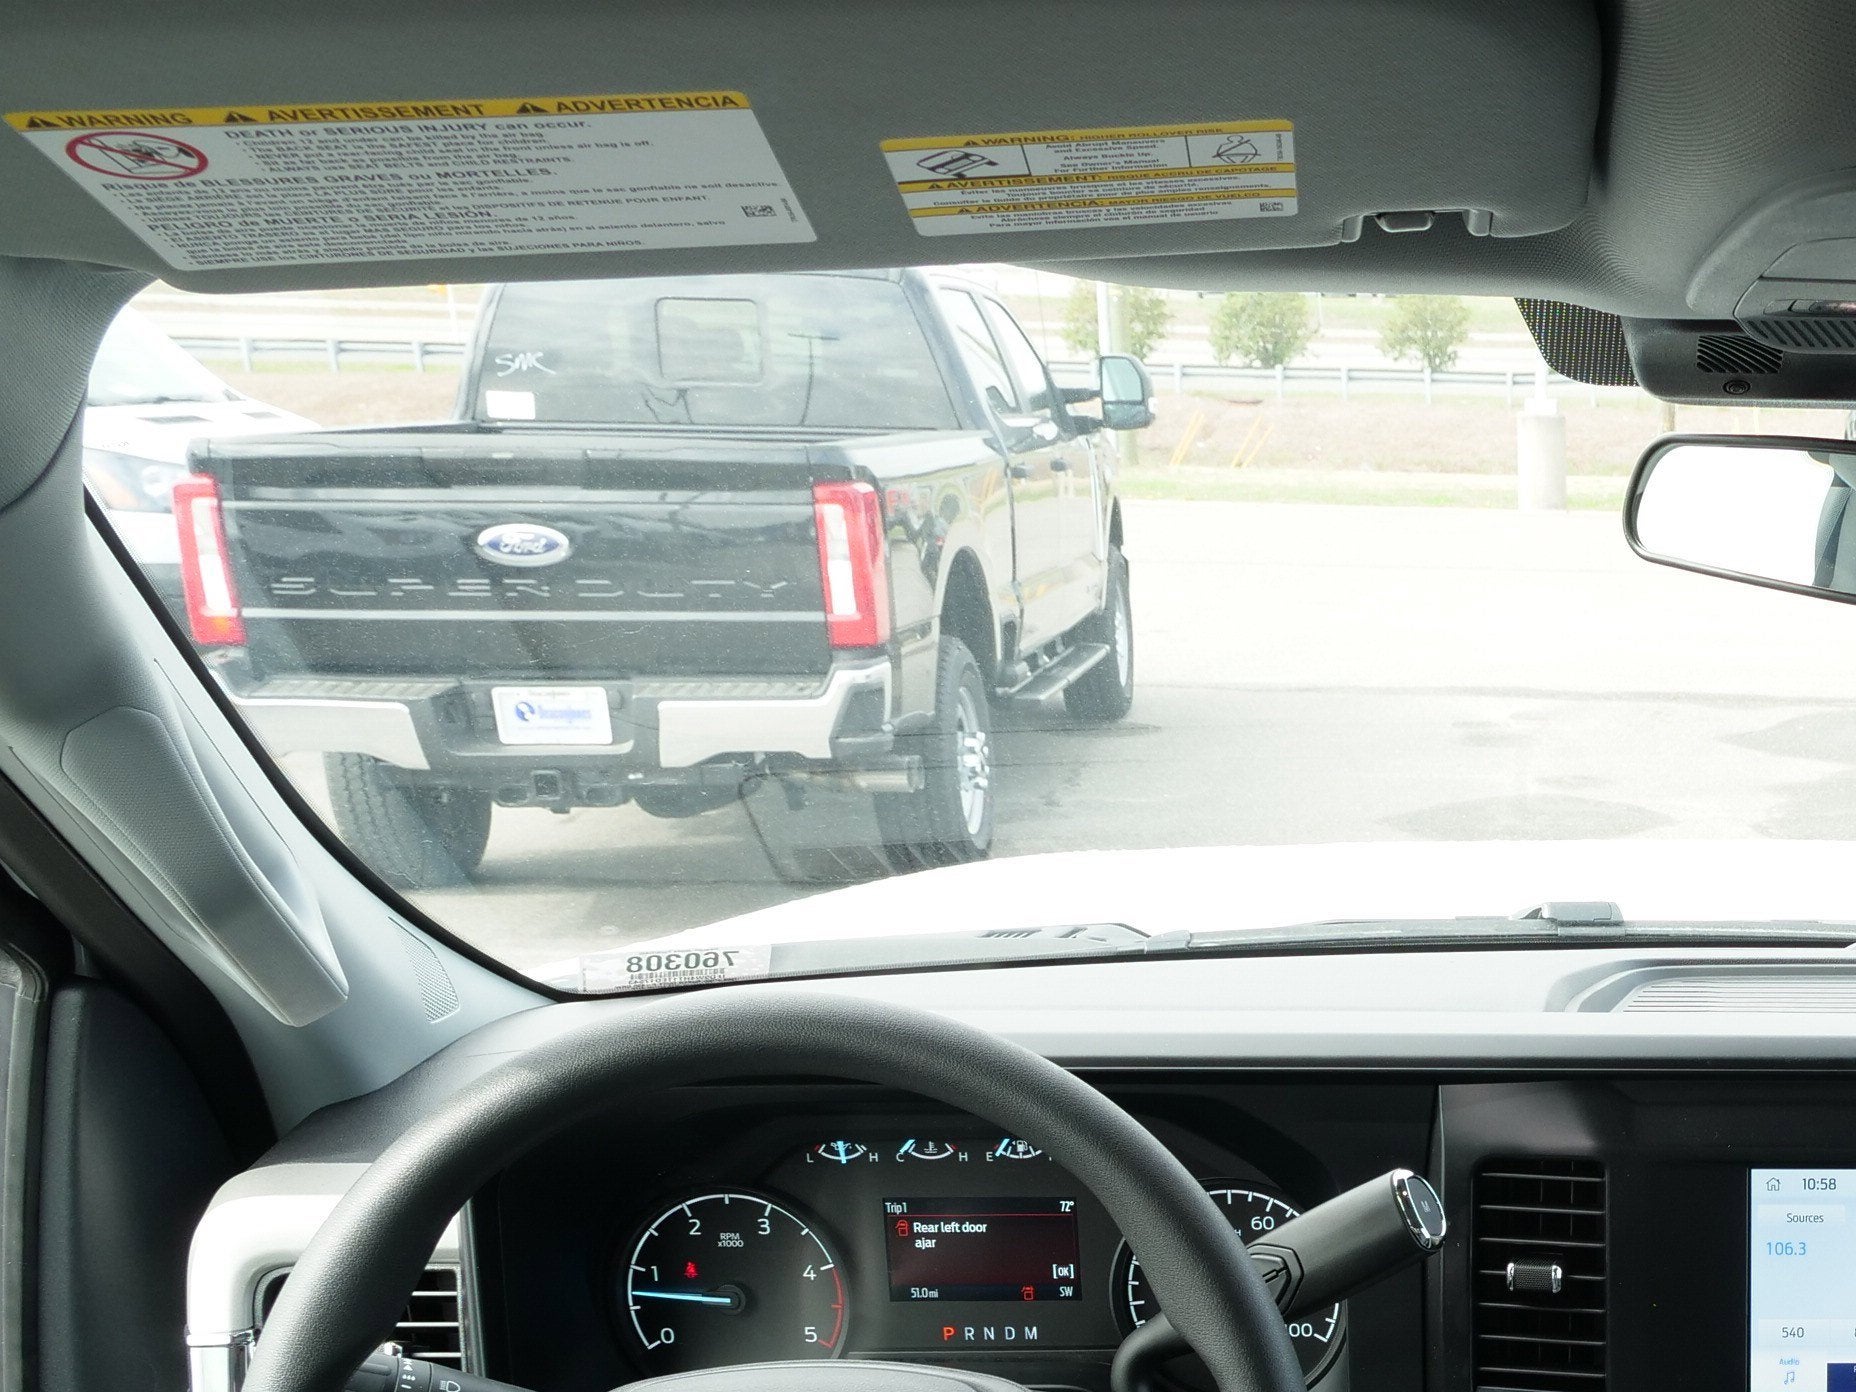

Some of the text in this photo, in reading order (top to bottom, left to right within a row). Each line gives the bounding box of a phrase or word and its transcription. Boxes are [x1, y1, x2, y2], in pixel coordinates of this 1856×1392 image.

[556, 93, 740, 114] ADVERTENCIA
[267, 103, 486, 122] AVERTISSEMENT
[57, 112, 193, 128] WARNING
[225, 120, 592, 140] DEATH or SERIOUS INJURY can occur.
[981, 133, 1075, 147] WARNING:
[806, 1152, 814, 1162] L
[869, 1152, 878, 1162] H
[896, 1152, 905, 1162] C
[958, 1152, 968, 1162] H
[986, 1152, 994, 1162] E
[1801, 1177, 1838, 1192] 10:58
[1060, 1200, 1074, 1212] 72°
[1250, 1216, 1275, 1231] 60
[1786, 1212, 1824, 1224] Sources
[688, 1219, 702, 1235] 2
[758, 1219, 771, 1235] 3
[913, 1222, 988, 1234] Rear left door
[717, 1240, 744, 1248] x1000
[914, 1238, 937, 1250] ajar
[1766, 1240, 1807, 1257] 106.3
[650, 1266, 658, 1282] 1
[802, 1264, 817, 1281] 4
[1059, 1286, 1073, 1298] SW
[660, 1328, 675, 1344] 0
[804, 1327, 818, 1343] 5
[943, 1326, 1038, 1341] P R N D M
[1781, 1326, 1805, 1340] 540
[1779, 1357, 1800, 1366] Audio
